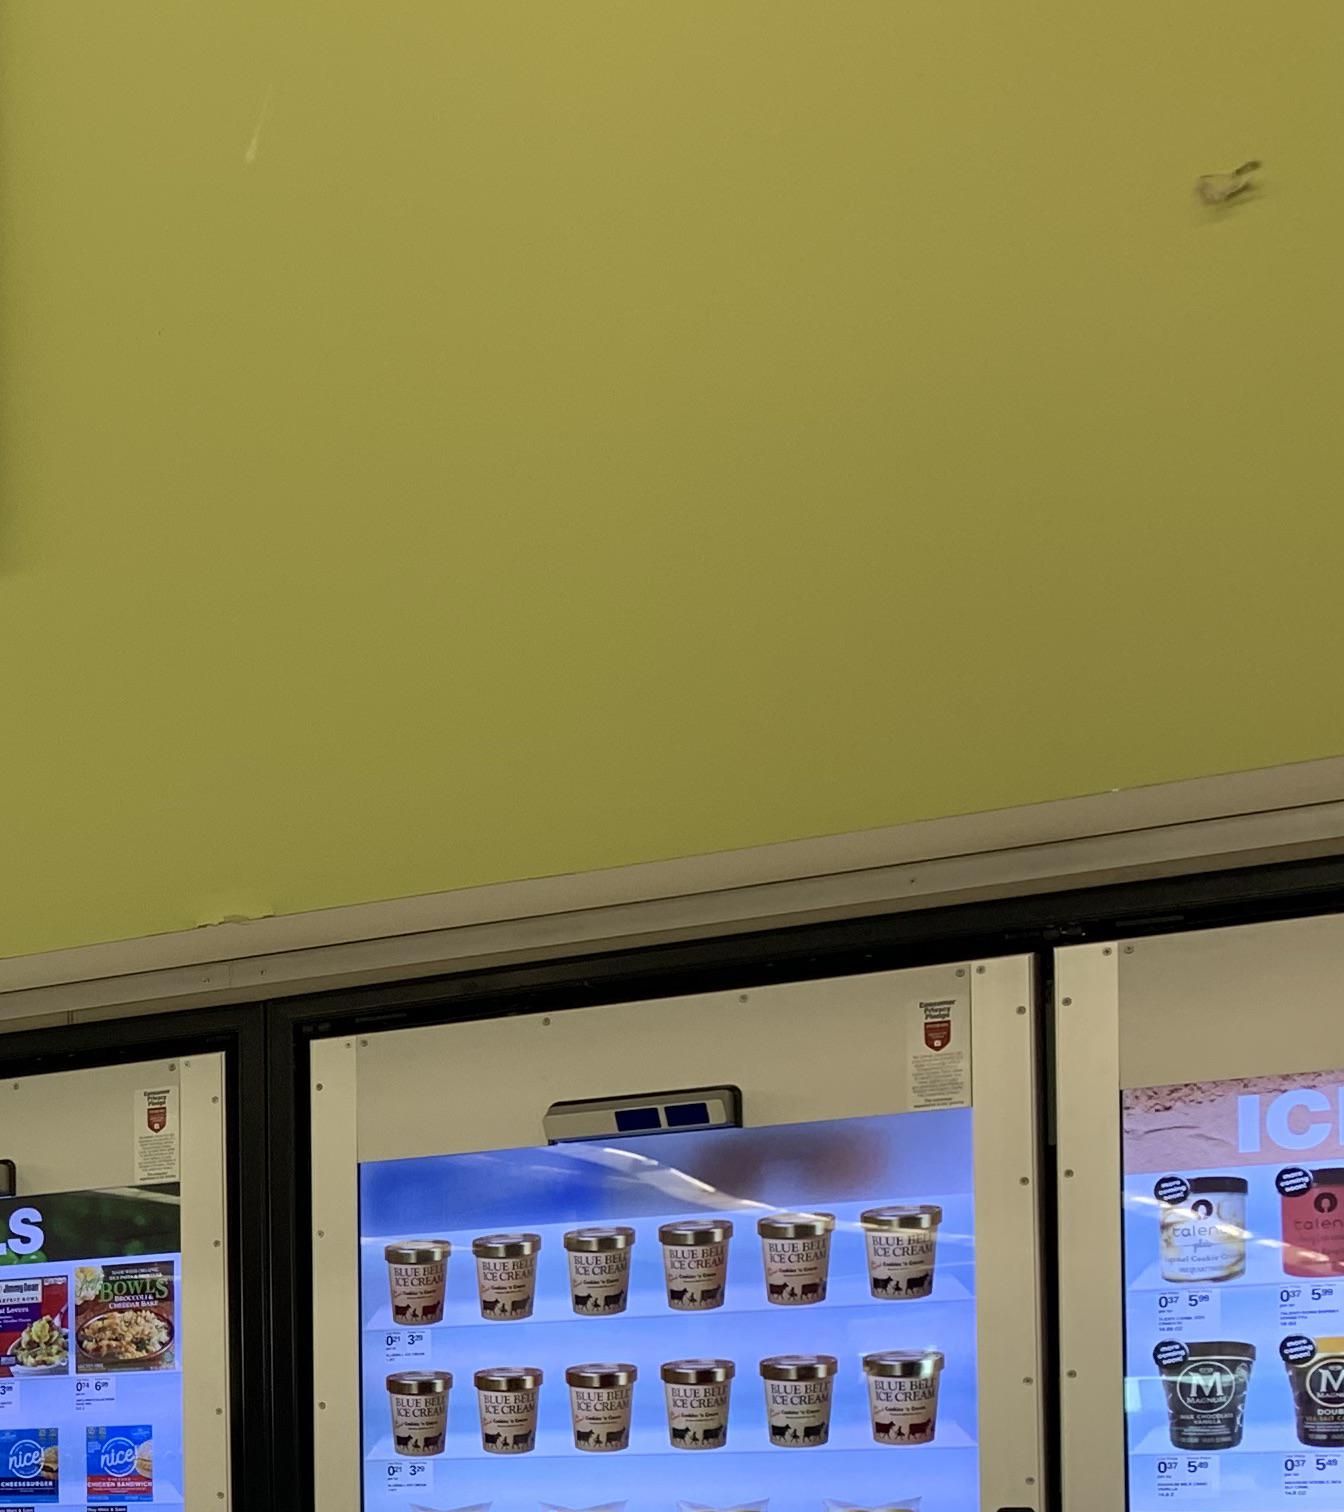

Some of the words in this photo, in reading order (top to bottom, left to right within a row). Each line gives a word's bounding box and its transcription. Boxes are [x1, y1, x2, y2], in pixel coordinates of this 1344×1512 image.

[1238, 1086, 1344, 1153] IC
[99, 1279, 169, 1302] BOWLS
[1186, 1396, 1227, 1405] MAGNUM
